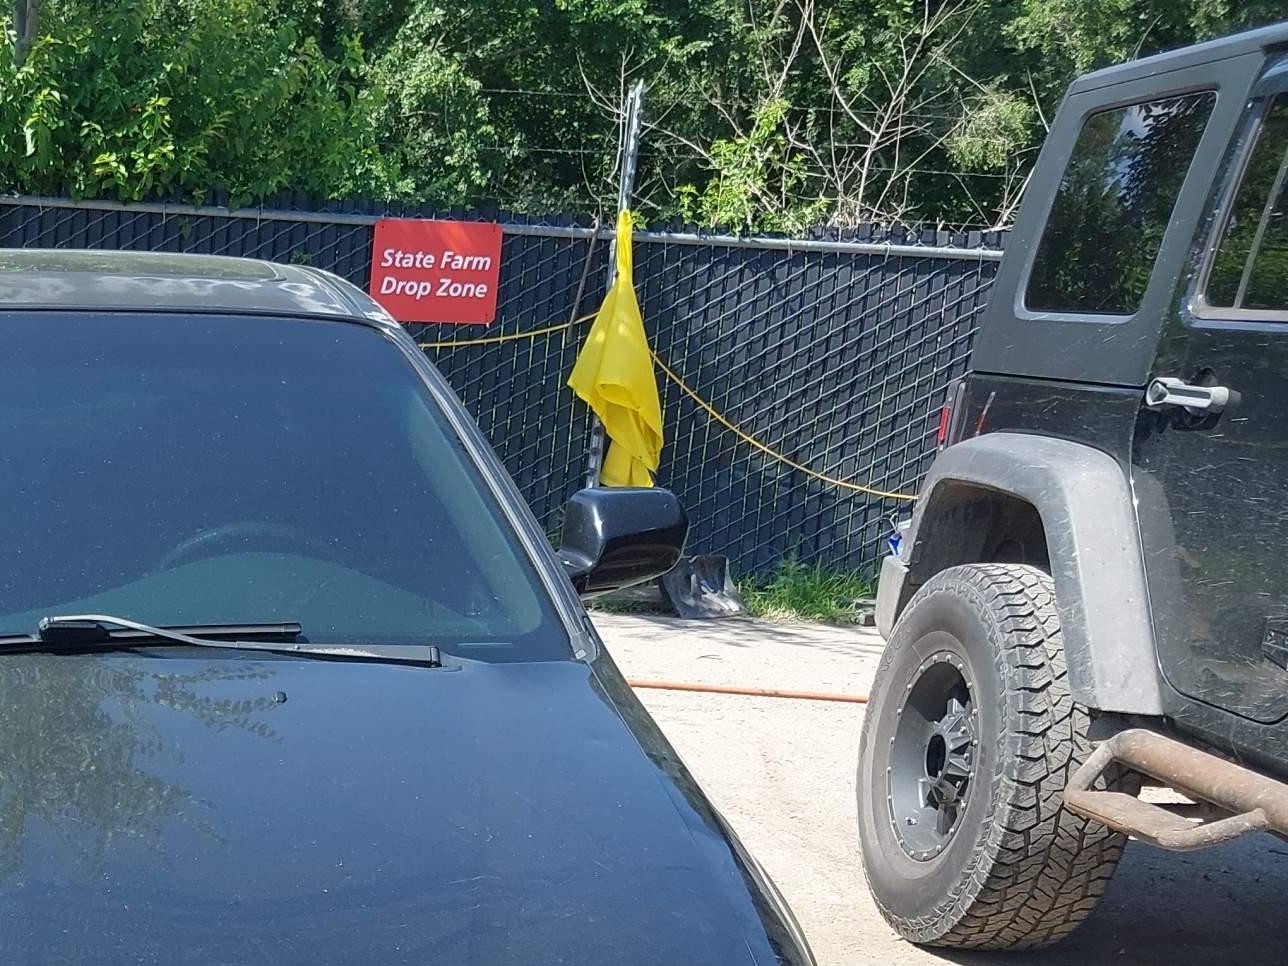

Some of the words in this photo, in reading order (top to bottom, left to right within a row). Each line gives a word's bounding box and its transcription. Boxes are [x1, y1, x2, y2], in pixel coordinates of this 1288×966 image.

[380, 248, 435, 269] State
[440, 251, 492, 271] Farm
[380, 276, 431, 300] Drop
[436, 278, 488, 298] Zone
